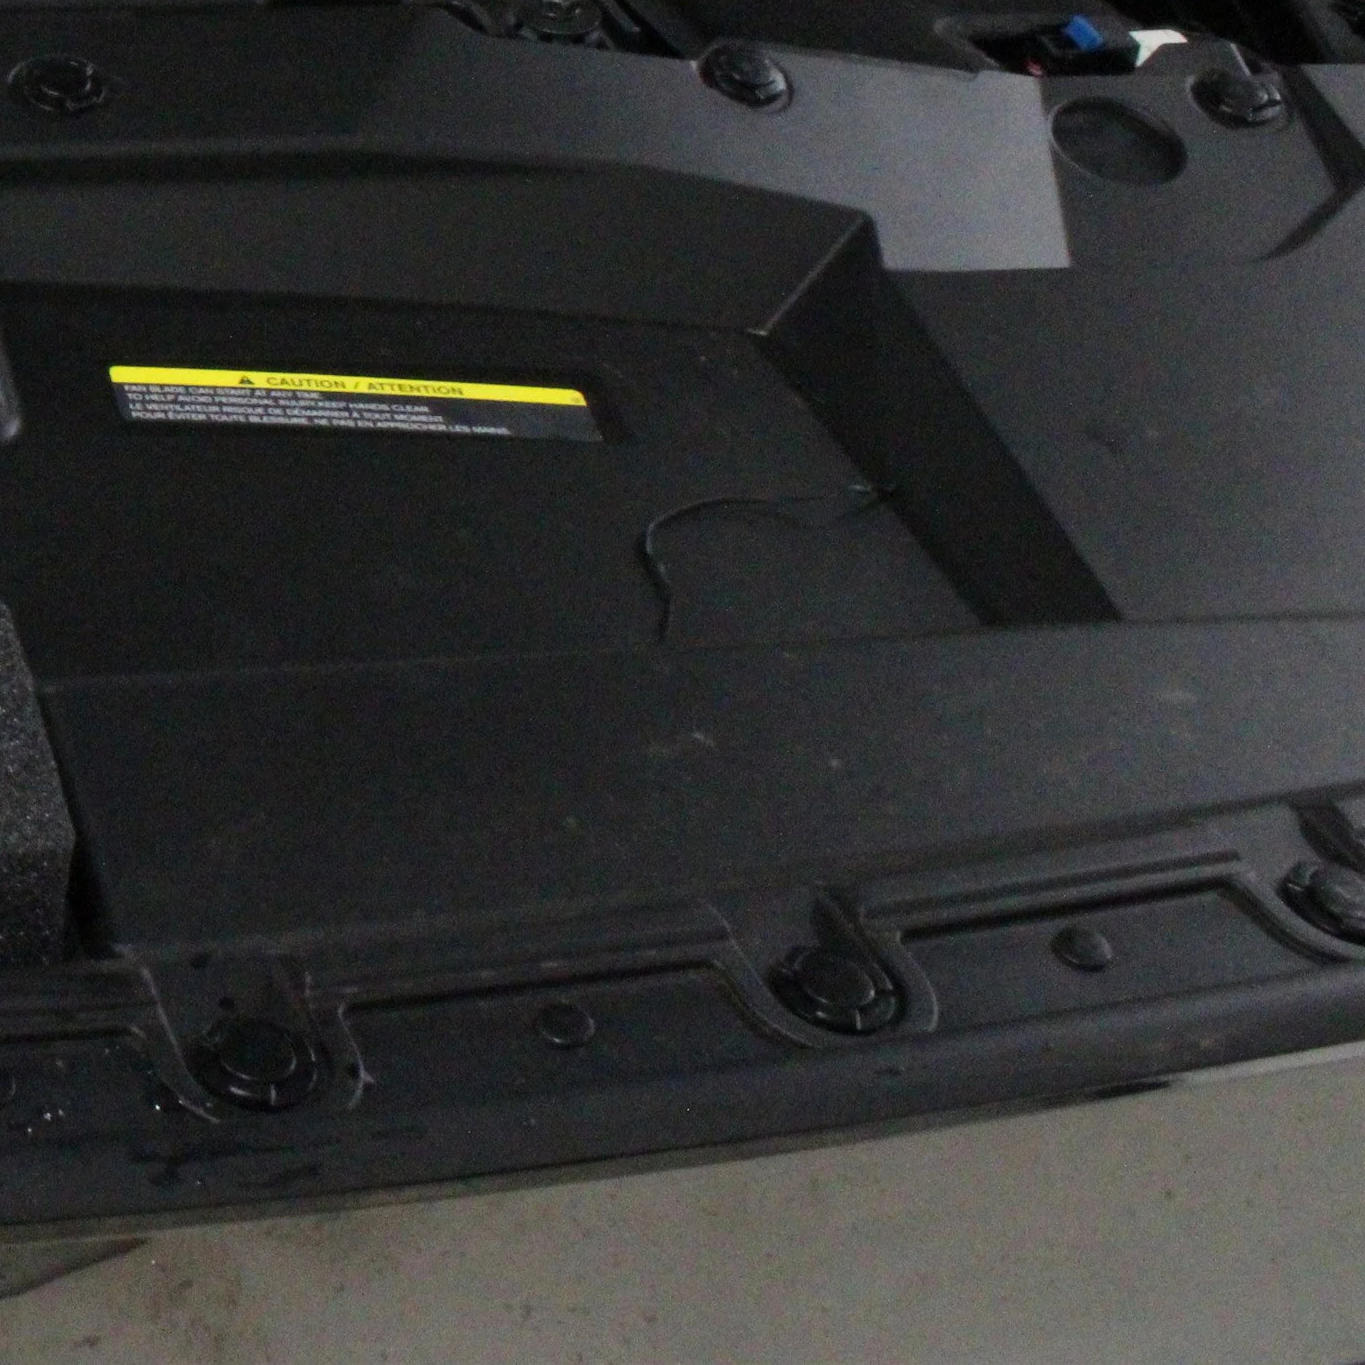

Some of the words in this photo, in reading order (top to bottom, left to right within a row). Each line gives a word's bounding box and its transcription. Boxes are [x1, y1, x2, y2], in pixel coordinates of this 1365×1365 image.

[266, 377, 346, 389] CAUTION
[367, 382, 464, 396] ATTENTION
[127, 393, 143, 401] TO
[177, 395, 213, 404] AVOID
